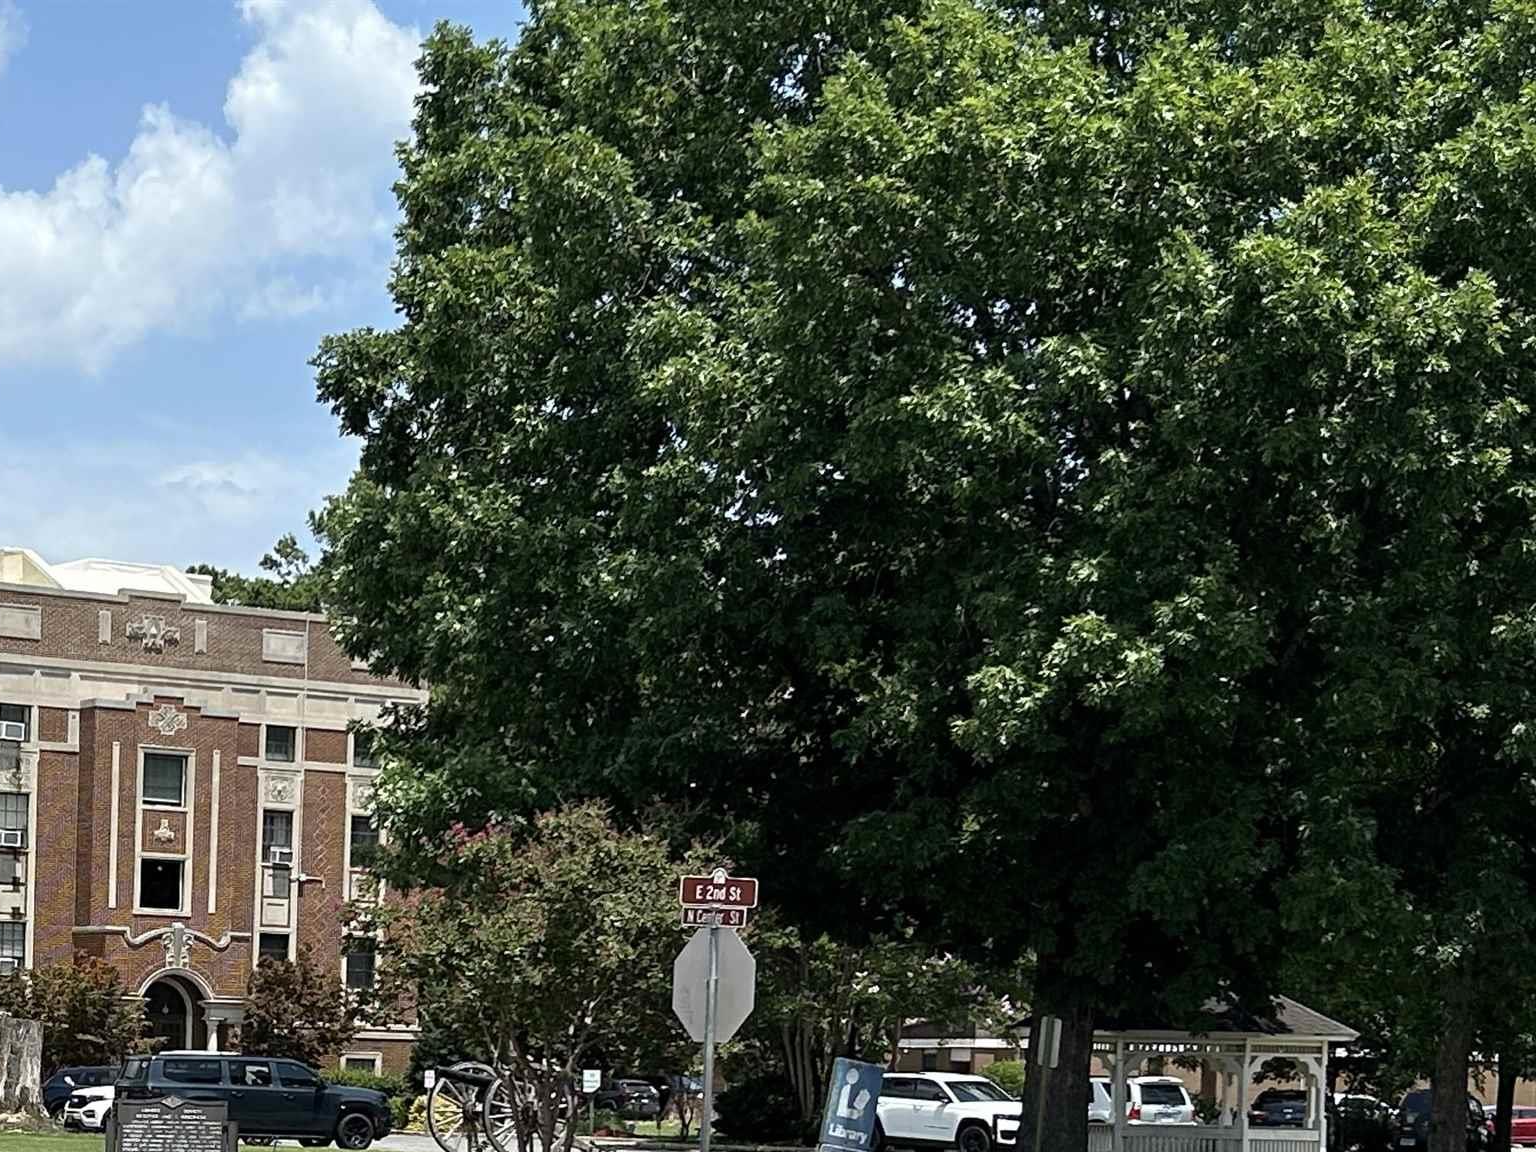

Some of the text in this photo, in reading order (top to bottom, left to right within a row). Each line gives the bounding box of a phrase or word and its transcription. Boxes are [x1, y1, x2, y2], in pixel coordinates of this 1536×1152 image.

[695, 885, 742, 901] E 2nd St
[687, 909, 695, 923] N
[729, 910, 740, 924] St
[828, 1123, 868, 1145] Library
